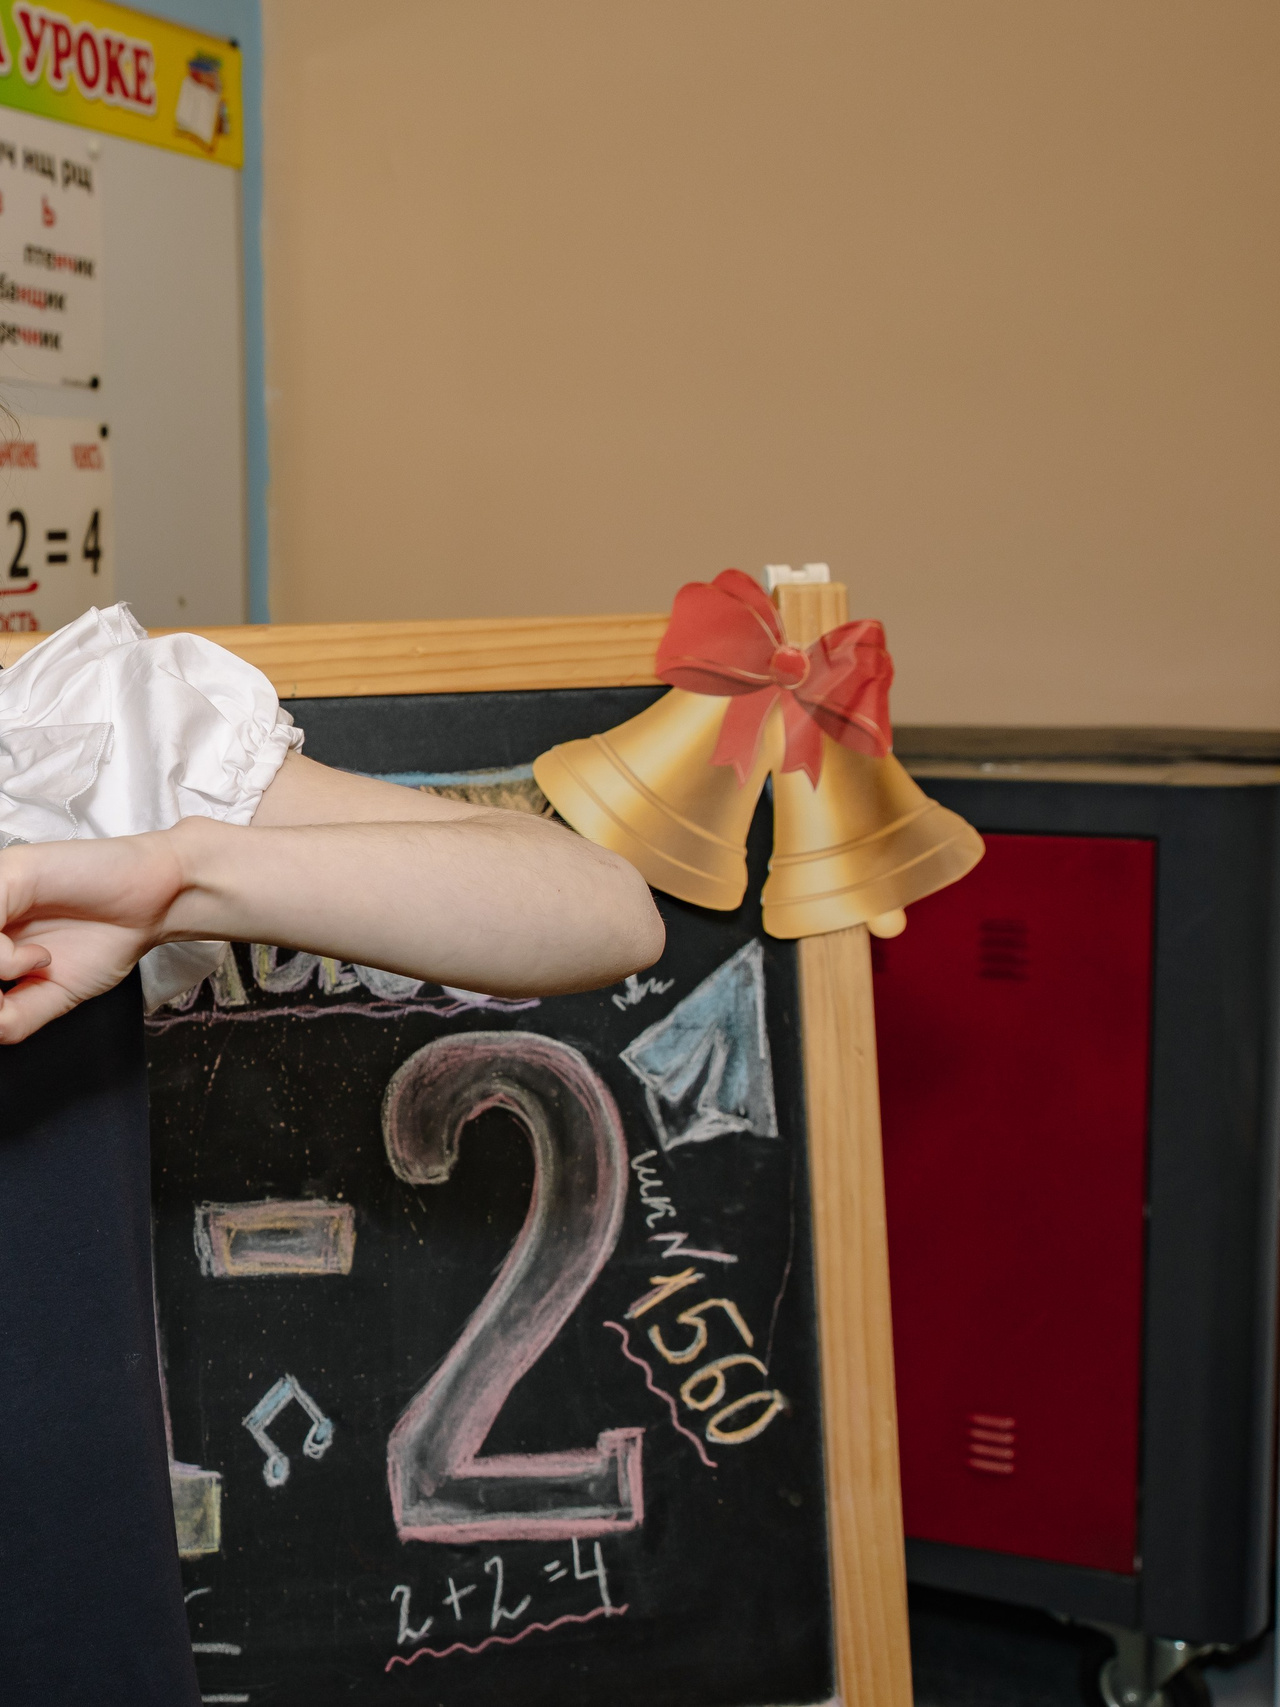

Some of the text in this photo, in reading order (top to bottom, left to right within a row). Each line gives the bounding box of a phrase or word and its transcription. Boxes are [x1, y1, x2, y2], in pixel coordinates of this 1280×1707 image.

[18, 10, 154, 106] УРОКЕ
[8, 509, 30, 578] 2
[83, 509, 102, 576] 4
[381, 1030, 647, 1543] 2
[623, 1267, 785, 1445] 1560
